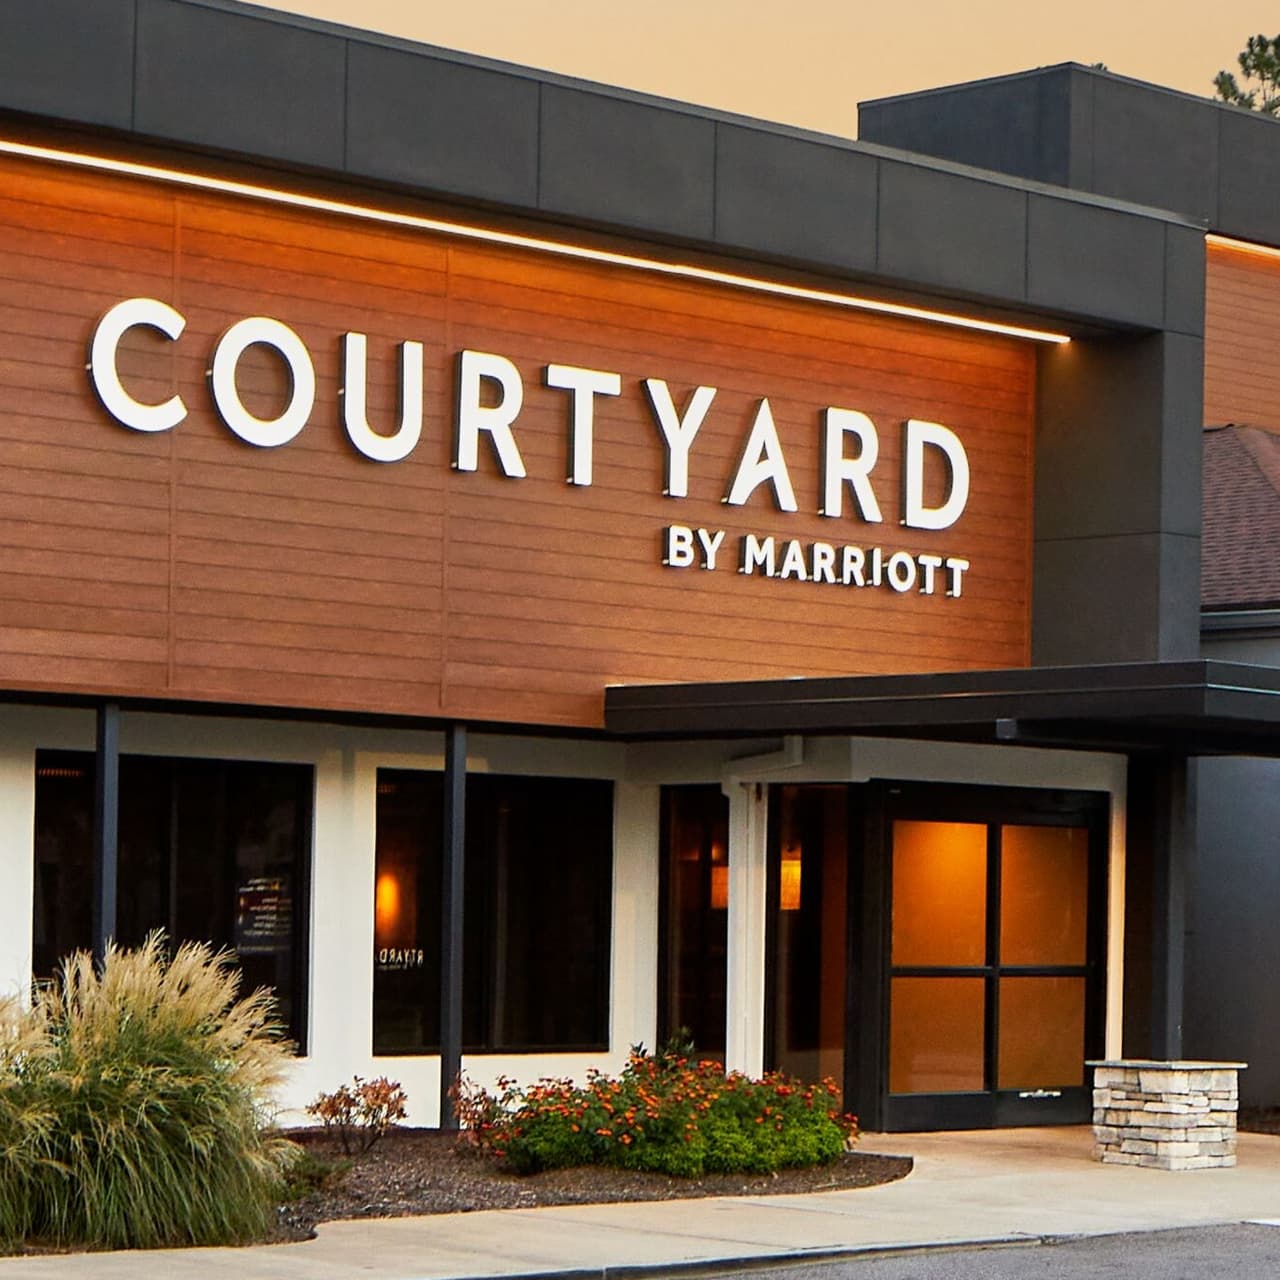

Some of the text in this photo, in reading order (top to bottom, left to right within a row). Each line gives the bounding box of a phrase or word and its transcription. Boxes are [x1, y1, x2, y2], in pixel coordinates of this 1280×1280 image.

[88, 298, 970, 531] COURTYARD
[665, 525, 970, 598] BY MARRIOTT
